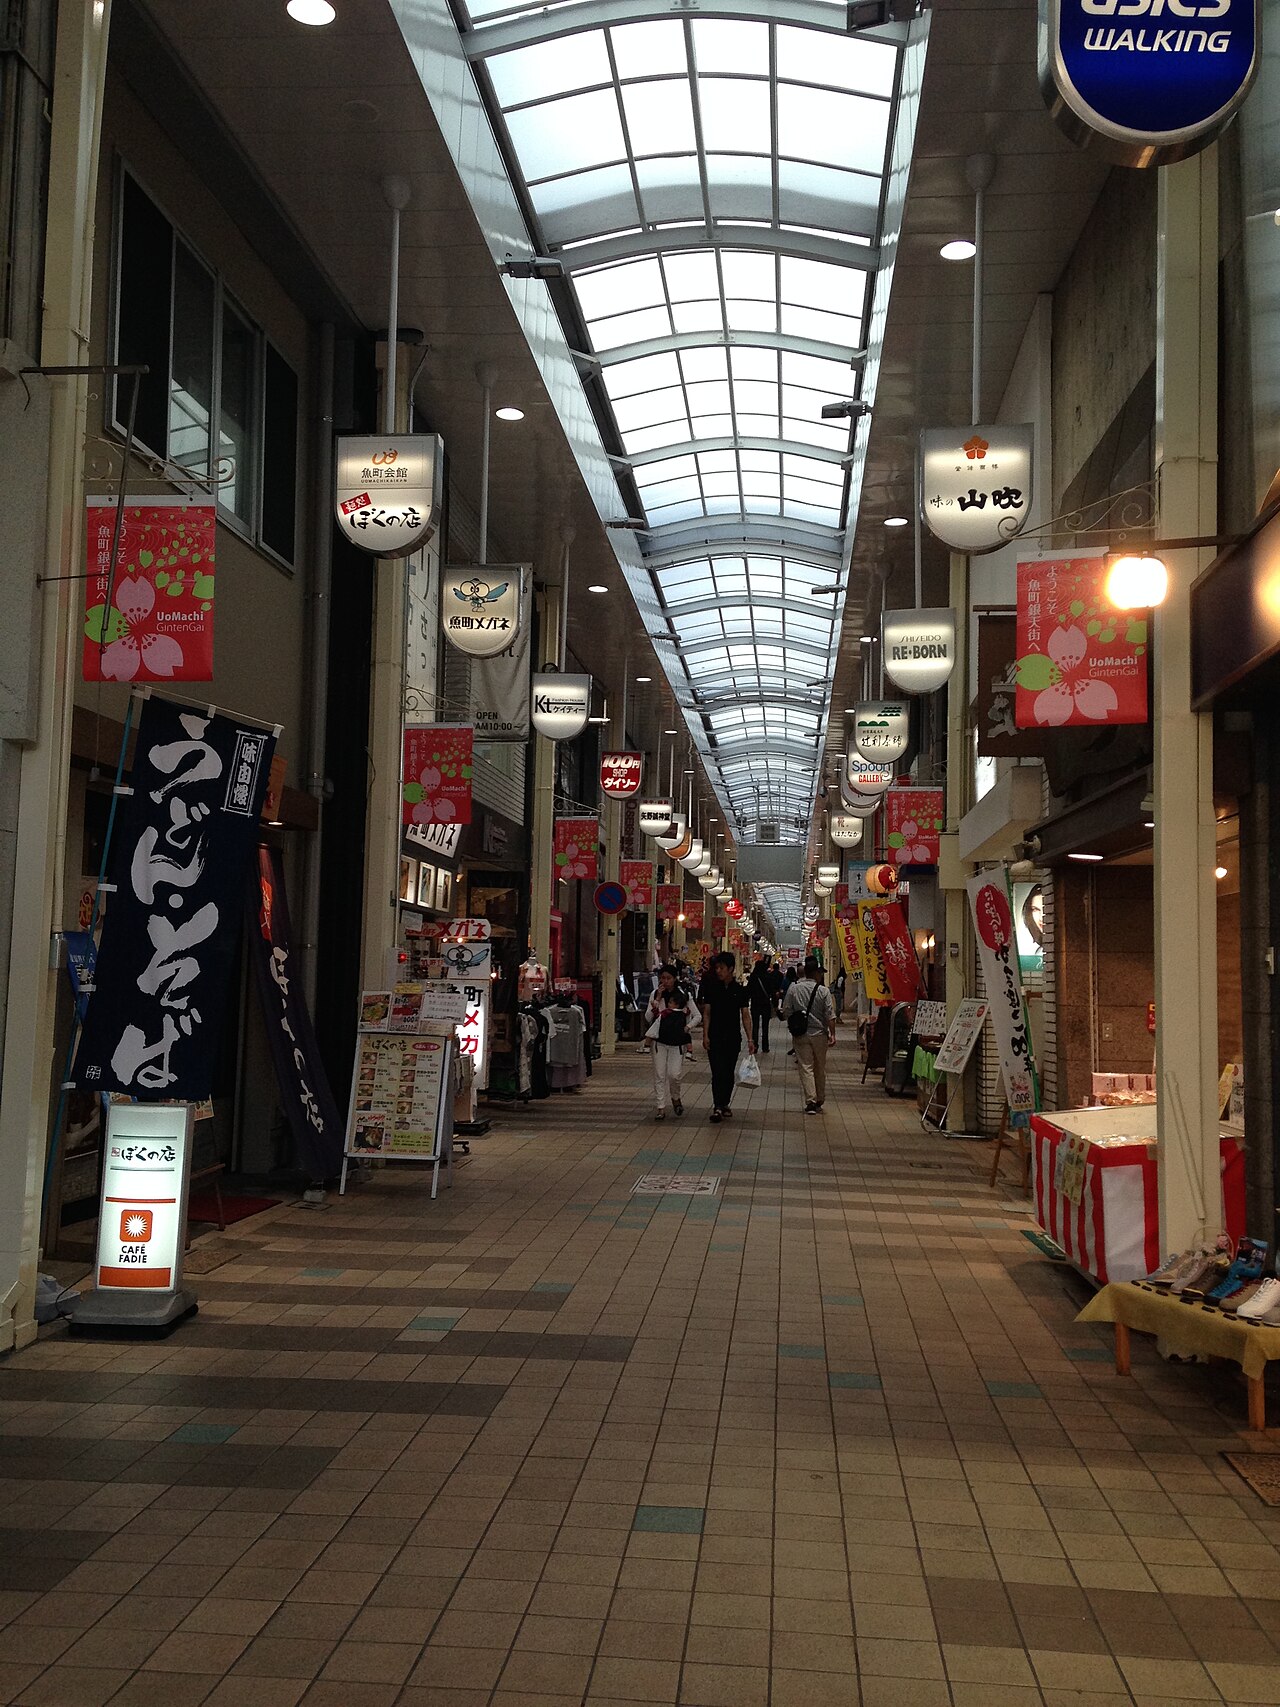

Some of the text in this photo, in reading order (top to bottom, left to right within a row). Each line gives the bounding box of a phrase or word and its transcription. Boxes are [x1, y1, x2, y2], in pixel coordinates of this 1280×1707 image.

[1083, 28, 1231, 52] WALKING
[361, 467, 408, 478] 魚町会館
[350, 507, 421, 529] ぼくの店
[1046, 565, 1058, 615] ようこそ
[157, 611, 203, 621] UoMachi
[1028, 578, 1041, 652] 魚町銀天街へ
[156, 622, 204, 632] GintenGai
[449, 616, 511, 630] 魚町メガネ
[899, 635, 942, 643] SHISEIDO
[1089, 656, 1137, 667] UoMachi
[1089, 667, 1138, 678] GintenGai
[476, 712, 498, 721] OPEN
[602, 755, 640, 769] 100円
[233, 742, 257, 806] 味自慢
[613, 769, 627, 778] SHOP
[604, 778, 636, 789] ダイソー
[436, 920, 487, 938] メガネ
[371, 1040, 407, 1052] ぼくの店
[121, 1145, 176, 1161] ぼくの店
[121, 1244, 146, 1254] CAFÉ
[118, 1254, 147, 1263] FADIE
